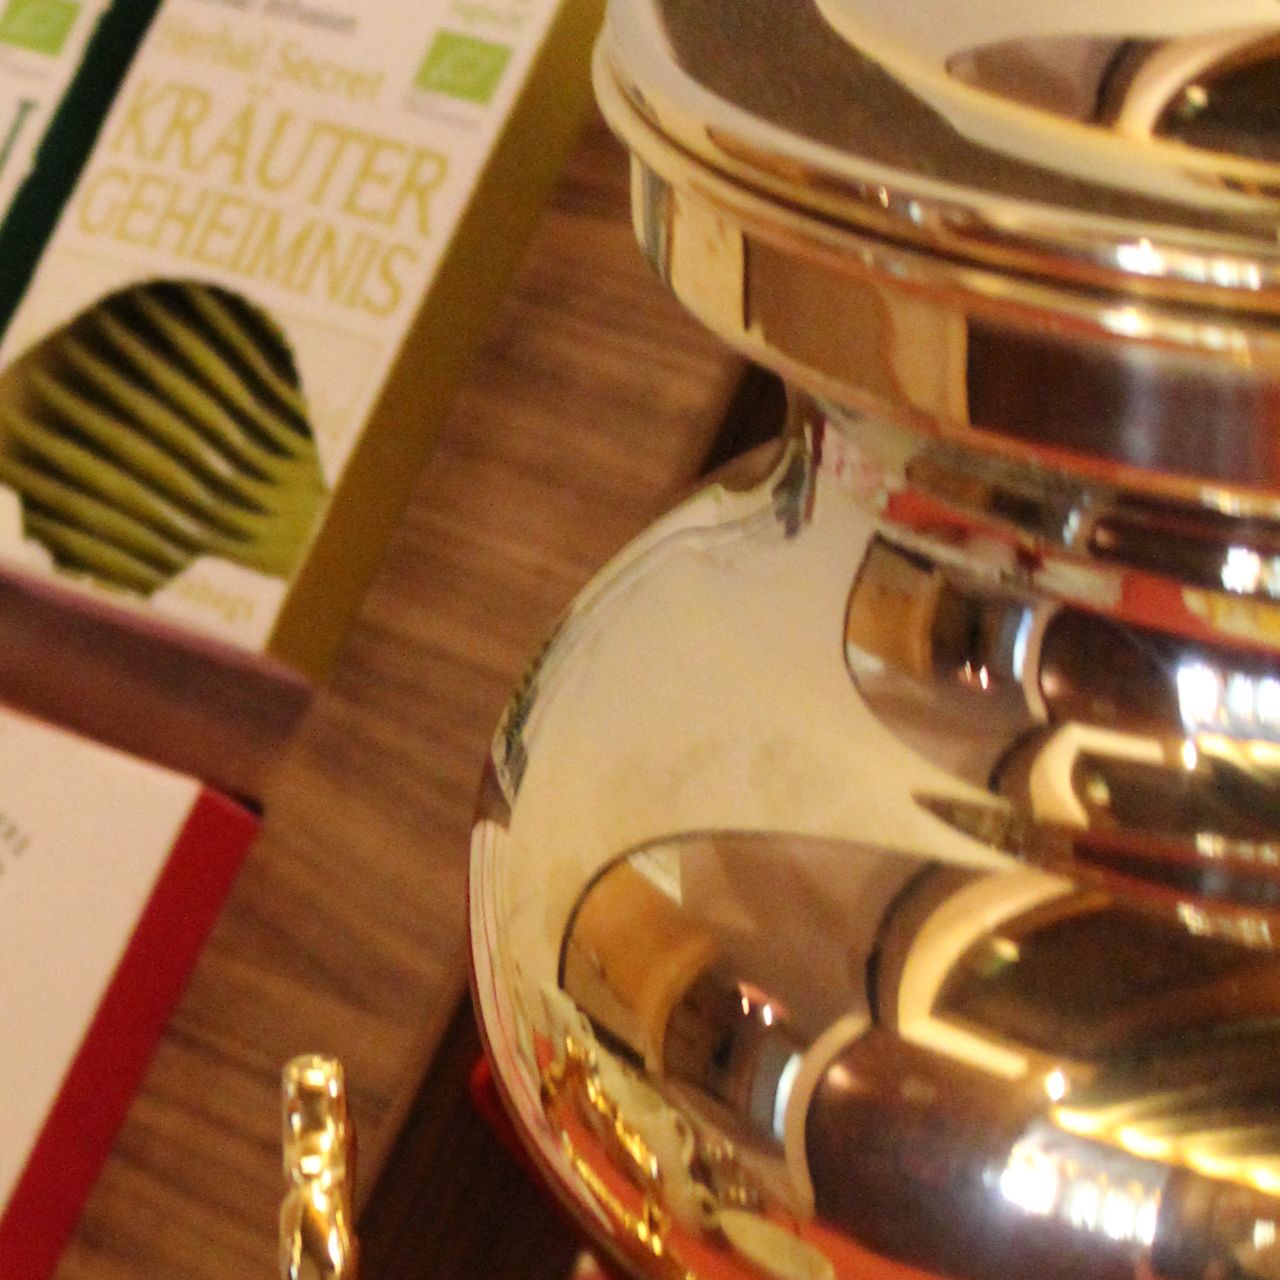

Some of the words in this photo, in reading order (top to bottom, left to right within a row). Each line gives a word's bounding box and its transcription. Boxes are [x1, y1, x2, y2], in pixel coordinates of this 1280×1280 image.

[271, 40, 387, 103] Secret
[109, 74, 451, 241] KRÄUTER
[77, 166, 419, 318] GEHEIMNIS
